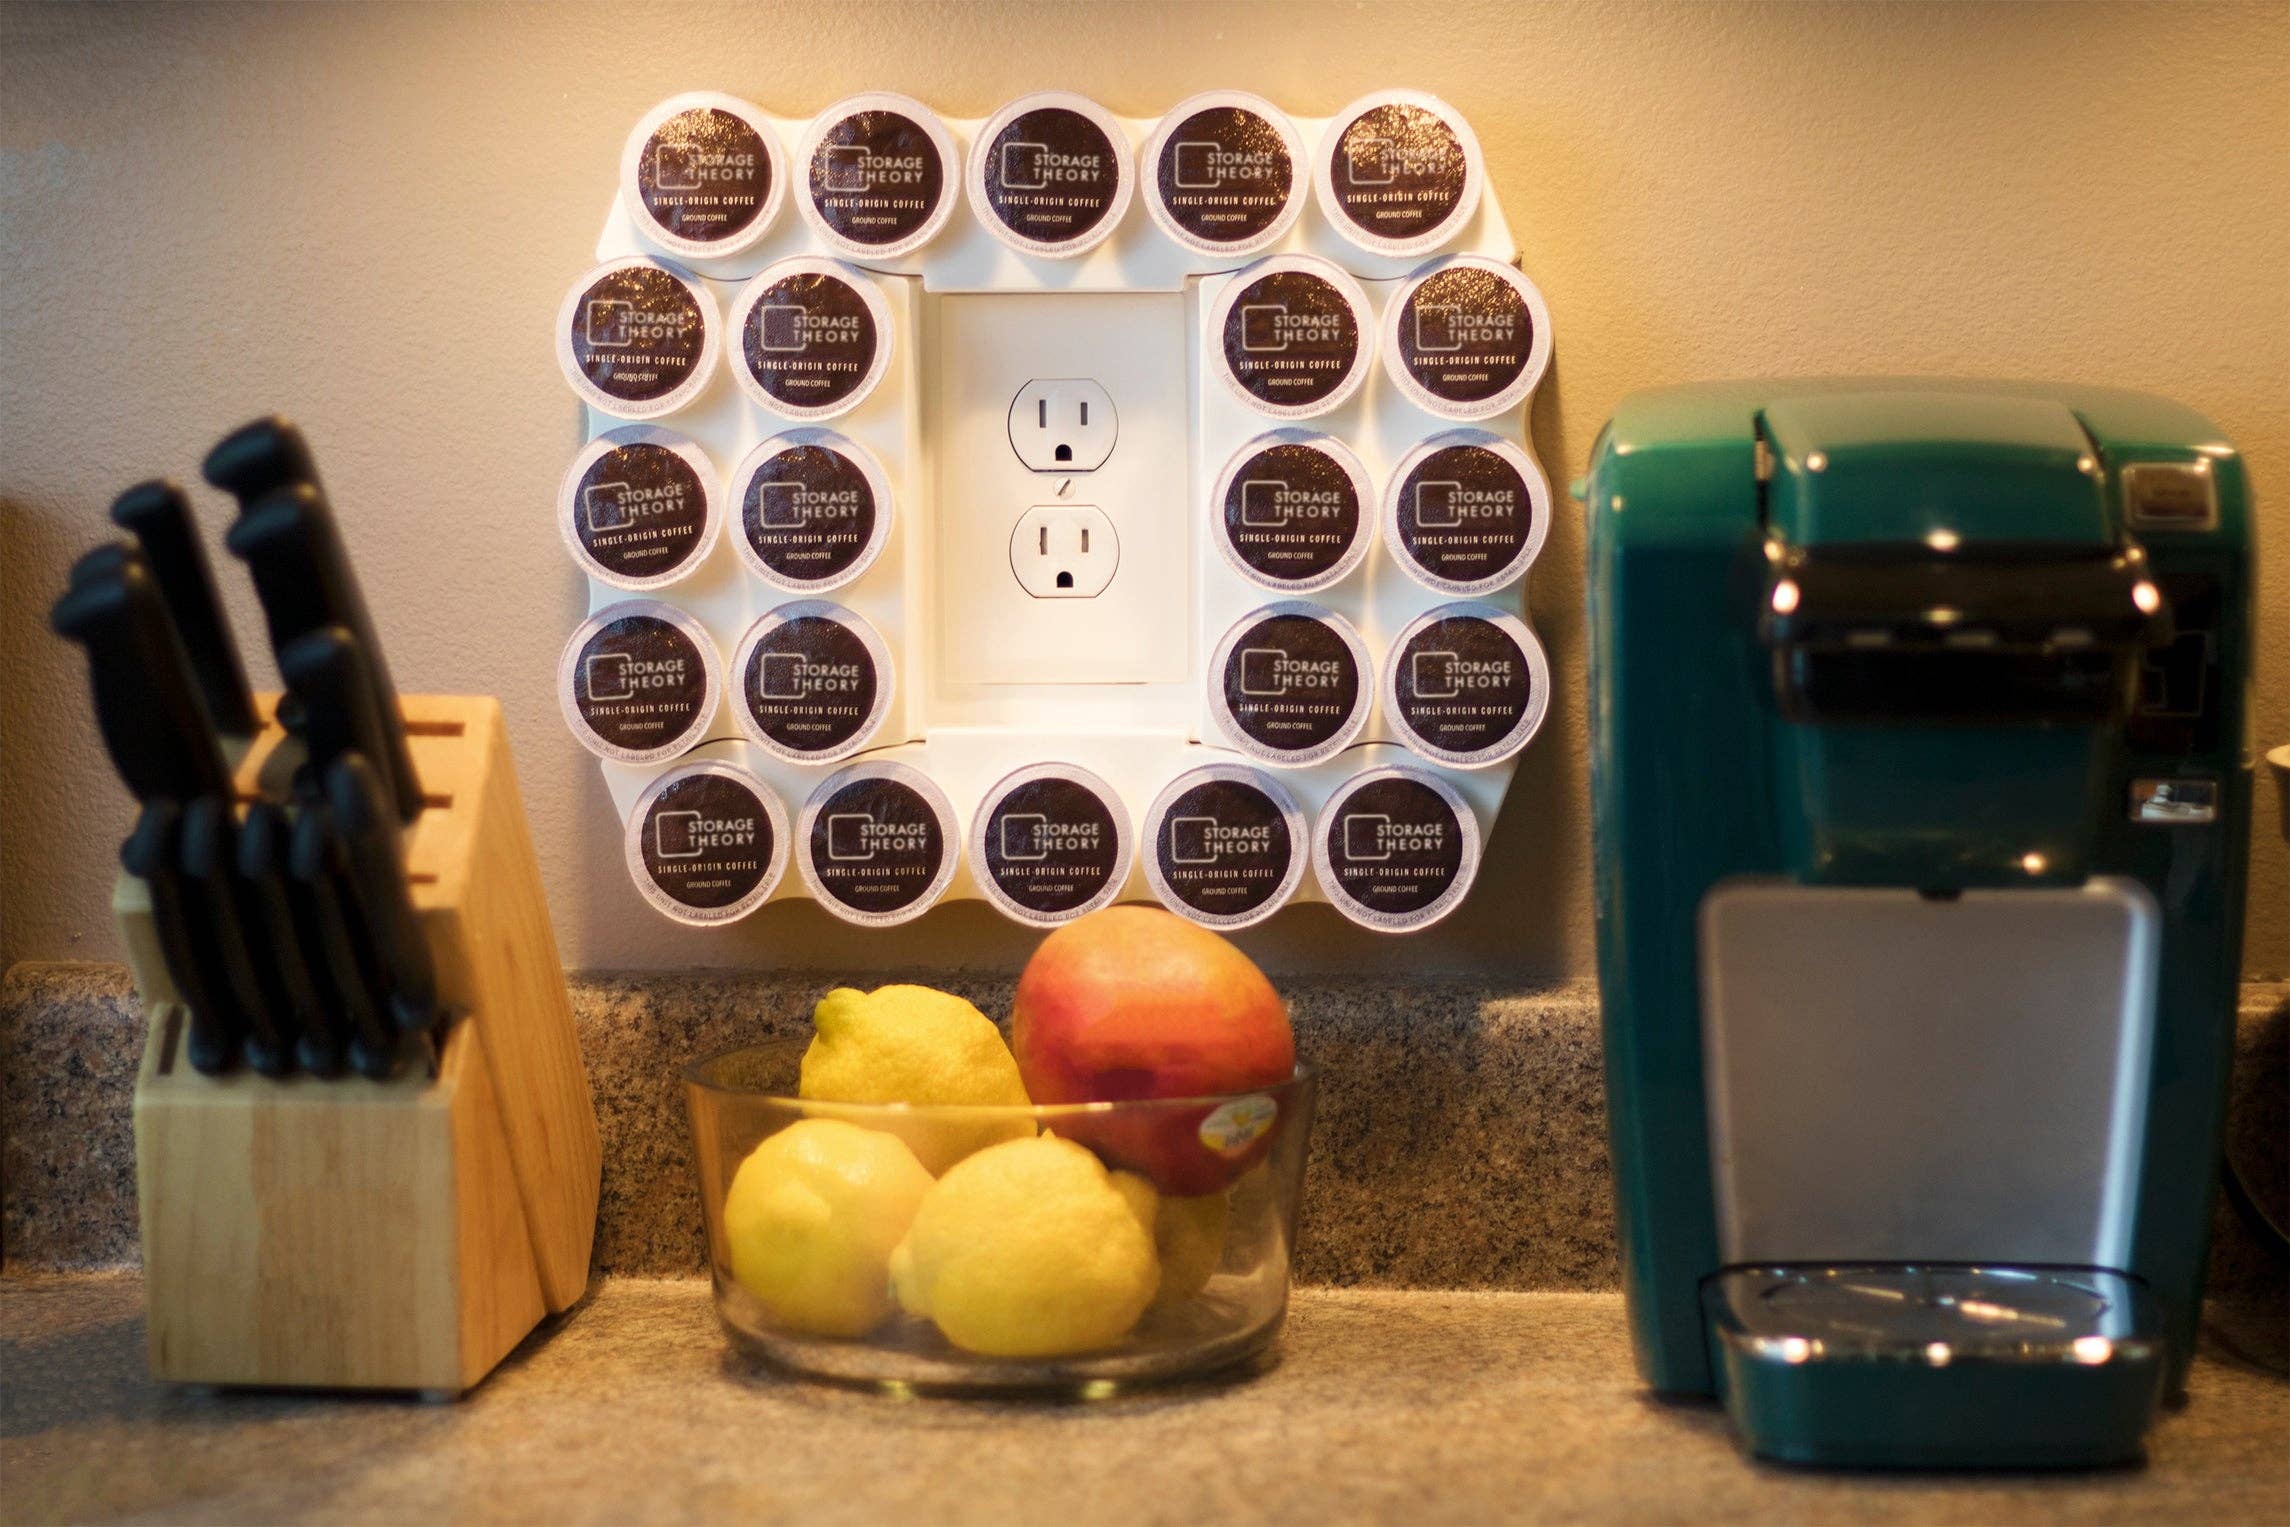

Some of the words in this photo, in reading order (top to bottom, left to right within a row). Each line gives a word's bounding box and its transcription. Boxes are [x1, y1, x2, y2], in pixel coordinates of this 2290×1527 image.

[858, 156, 922, 169] STORAGE
[1034, 153, 1100, 168] STORAGE
[1208, 152, 1273, 165] STORAGE
[689, 168, 754, 180] THEORY
[858, 170, 922, 183] THEORY
[1034, 167, 1099, 182] THEORY
[1208, 166, 1272, 179] THEORY
[653, 197, 719, 205] SINGLE-ORIGIN
[723, 197, 754, 205] COFFEE
[998, 195, 1064, 206] SINGLE-ORIGIN
[1068, 198, 1099, 208] COFFEE
[1173, 196, 1238, 205] SINGLE-ORIGIN
[1242, 197, 1274, 205] COFFEE
[1347, 193, 1413, 202] SINGLE-ORIGIN
[1417, 192, 1449, 201] COFFEE
[823, 199, 888, 208] SINGLE-ORIGIN
[893, 200, 924, 209] COFFEE
[852, 216, 876, 224] GROUND
[1026, 214, 1050, 222] GROUND
[620, 311, 685, 325] STORAGE
[794, 315, 859, 330] STORAGE
[1274, 315, 1340, 327] STORAGE
[1449, 315, 1514, 327] STORAGE
[620, 325, 684, 339] THEORY
[793, 330, 858, 344] THEORY
[1274, 329, 1339, 341] THEORY
[1449, 329, 1514, 340] THEORY
[585, 354, 650, 365] SINGLE-ORIGIN
[654, 356, 686, 365] COFFEE
[758, 360, 823, 370] SINGLE-ORIGIN
[827, 362, 858, 371] COFFEE
[1239, 360, 1305, 369] SINGLE-ORIGIN
[1309, 360, 1341, 368] COFFEE
[1414, 358, 1480, 366] SINGLE-ORIGIN
[1484, 357, 1516, 365] COFFEE
[785, 378, 810, 386] GROUND
[810, 379, 831, 387] COFFEE
[618, 485, 683, 504] STORAGE
[793, 492, 857, 504] STORAGE
[1275, 491, 1340, 504] STORAGE
[1448, 491, 1514, 503] STORAGE
[621, 498, 684, 517] THEORY
[793, 505, 857, 517] THEORY
[1275, 505, 1340, 518] THEORY
[1448, 505, 1514, 517] THEORY
[593, 531, 657, 547] SINGLE-ORIGIN
[661, 526, 692, 537] COFFEE
[758, 535, 823, 544] SINGLE-ORIGIN
[827, 535, 859, 543] COFFEE
[1239, 534, 1305, 543] SINGLE-ORIGIN
[1309, 535, 1341, 544] COFFEE
[1413, 536, 1479, 544] SINGLE-ORIGIN
[1483, 536, 1515, 544] COFFEE
[623, 550, 648, 559] GROUND
[648, 546, 669, 555] COFFEE
[1267, 551, 1292, 559] GROUND
[1441, 553, 1466, 561] GROUND
[619, 660, 684, 675] STORAGE
[794, 664, 858, 677] STORAGE
[1274, 660, 1339, 674] STORAGE
[1446, 662, 1511, 674] STORAGE
[621, 674, 685, 689] THEORY
[793, 677, 858, 691] THEORY
[1274, 674, 1339, 688] THEORY
[1446, 676, 1511, 688] THEORY
[589, 705, 654, 717] SINGLE-ORIGIN
[658, 703, 690, 712] COFFEE
[758, 706, 823, 715] SINGLE-ORIGIN
[827, 707, 859, 716] COFFEE
[1239, 703, 1304, 714] SINGLE-ORIGIN
[1308, 705, 1340, 714] COFFEE
[1411, 707, 1476, 715] SINGLE-ORIGIN
[1481, 706, 1512, 714] COFFEE
[619, 723, 644, 731] GROUND
[644, 721, 665, 729] COFFEE
[1267, 721, 1291, 729] GROUND
[1292, 722, 1313, 730] COFFEE
[689, 819, 754, 833] STORAGE
[861, 824, 926, 836] STORAGE
[1034, 824, 1099, 836] STORAGE
[1377, 824, 1442, 836] STORAGE
[690, 832, 754, 846] THEORY
[1204, 827, 1269, 839] STORAGE
[861, 838, 925, 850] THEORY
[1034, 838, 1099, 849] THEORY
[1205, 840, 1270, 853] THEORY
[1378, 838, 1443, 850] THEORY
[657, 863, 722, 874] SINGLE-ORIGIN
[726, 861, 757, 871] COFFEE
[826, 868, 891, 876] SINGLE-ORIGIN
[895, 868, 927, 876] COFFEE
[1069, 867, 1101, 875] COFFEE
[1413, 868, 1445, 876] COFFEE
[1172, 871, 1238, 879] SINGLE-ORIGIN
[1242, 870, 1273, 878] COFFEE
